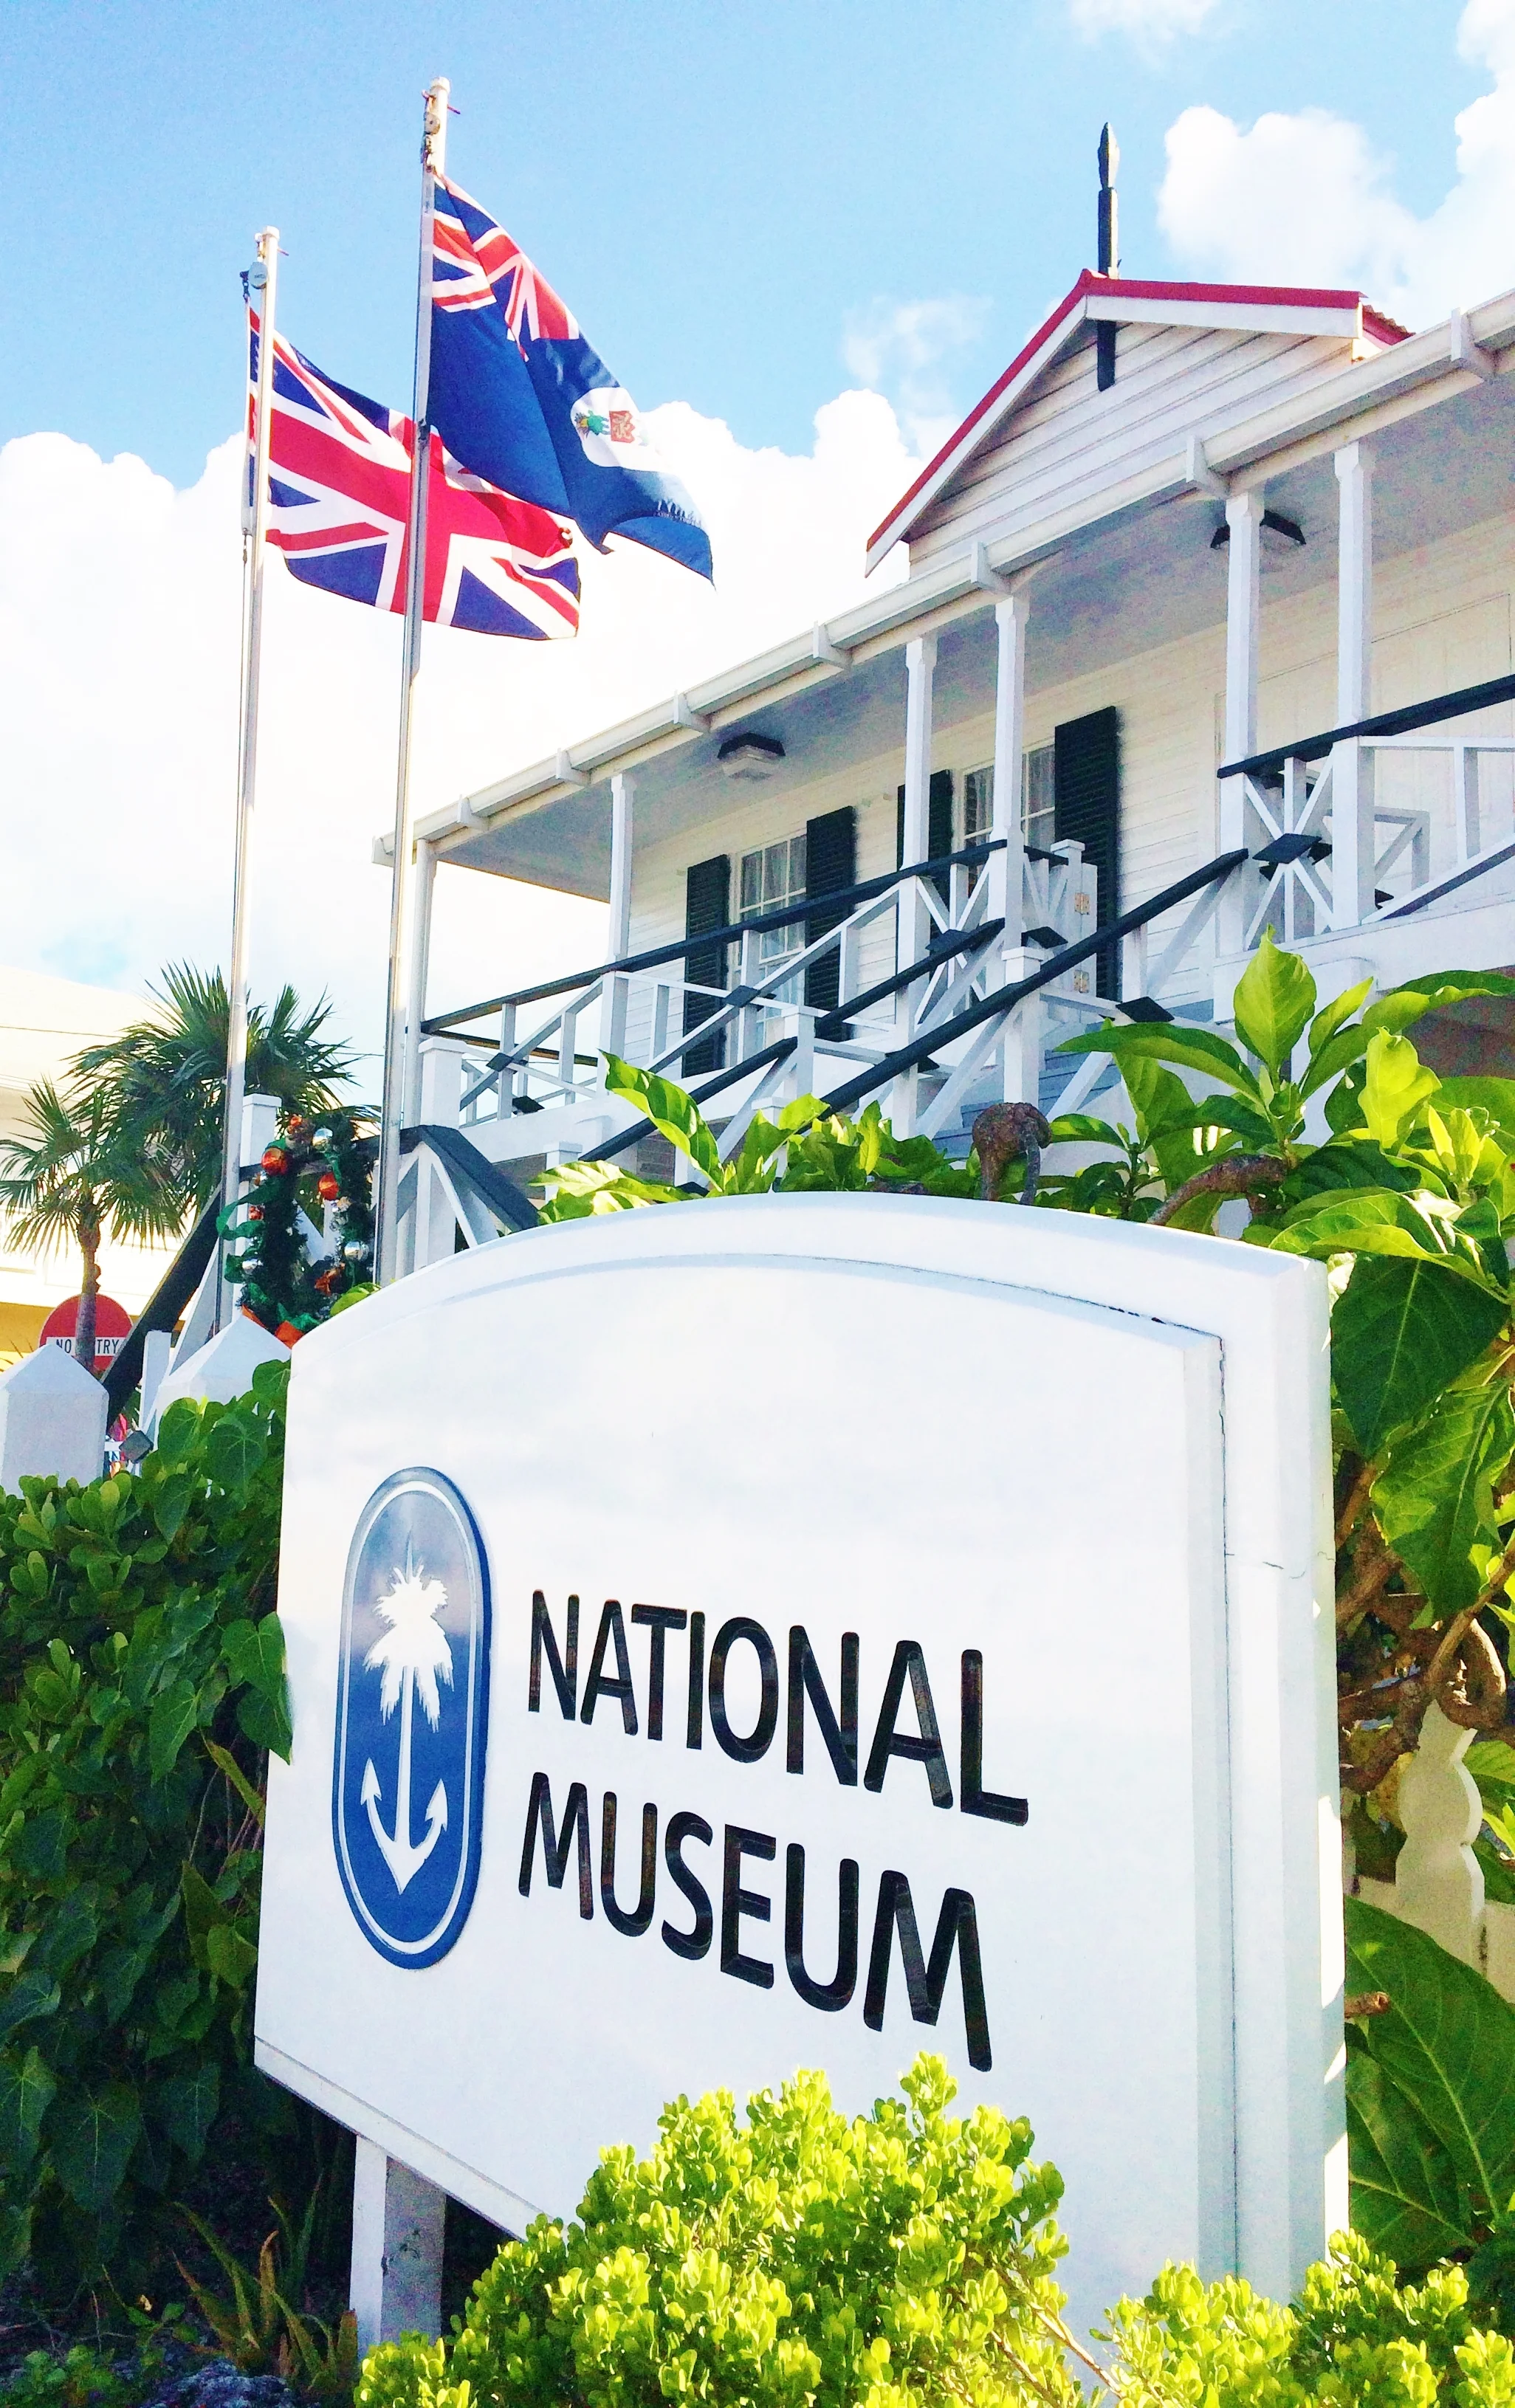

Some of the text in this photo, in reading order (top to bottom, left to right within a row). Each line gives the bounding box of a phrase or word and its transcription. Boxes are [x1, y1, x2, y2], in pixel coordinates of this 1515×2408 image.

[95, 1339, 120, 1354] TRY
[529, 1589, 1028, 1826] NATIONAL
[518, 1772, 992, 2072] MUSEUM
